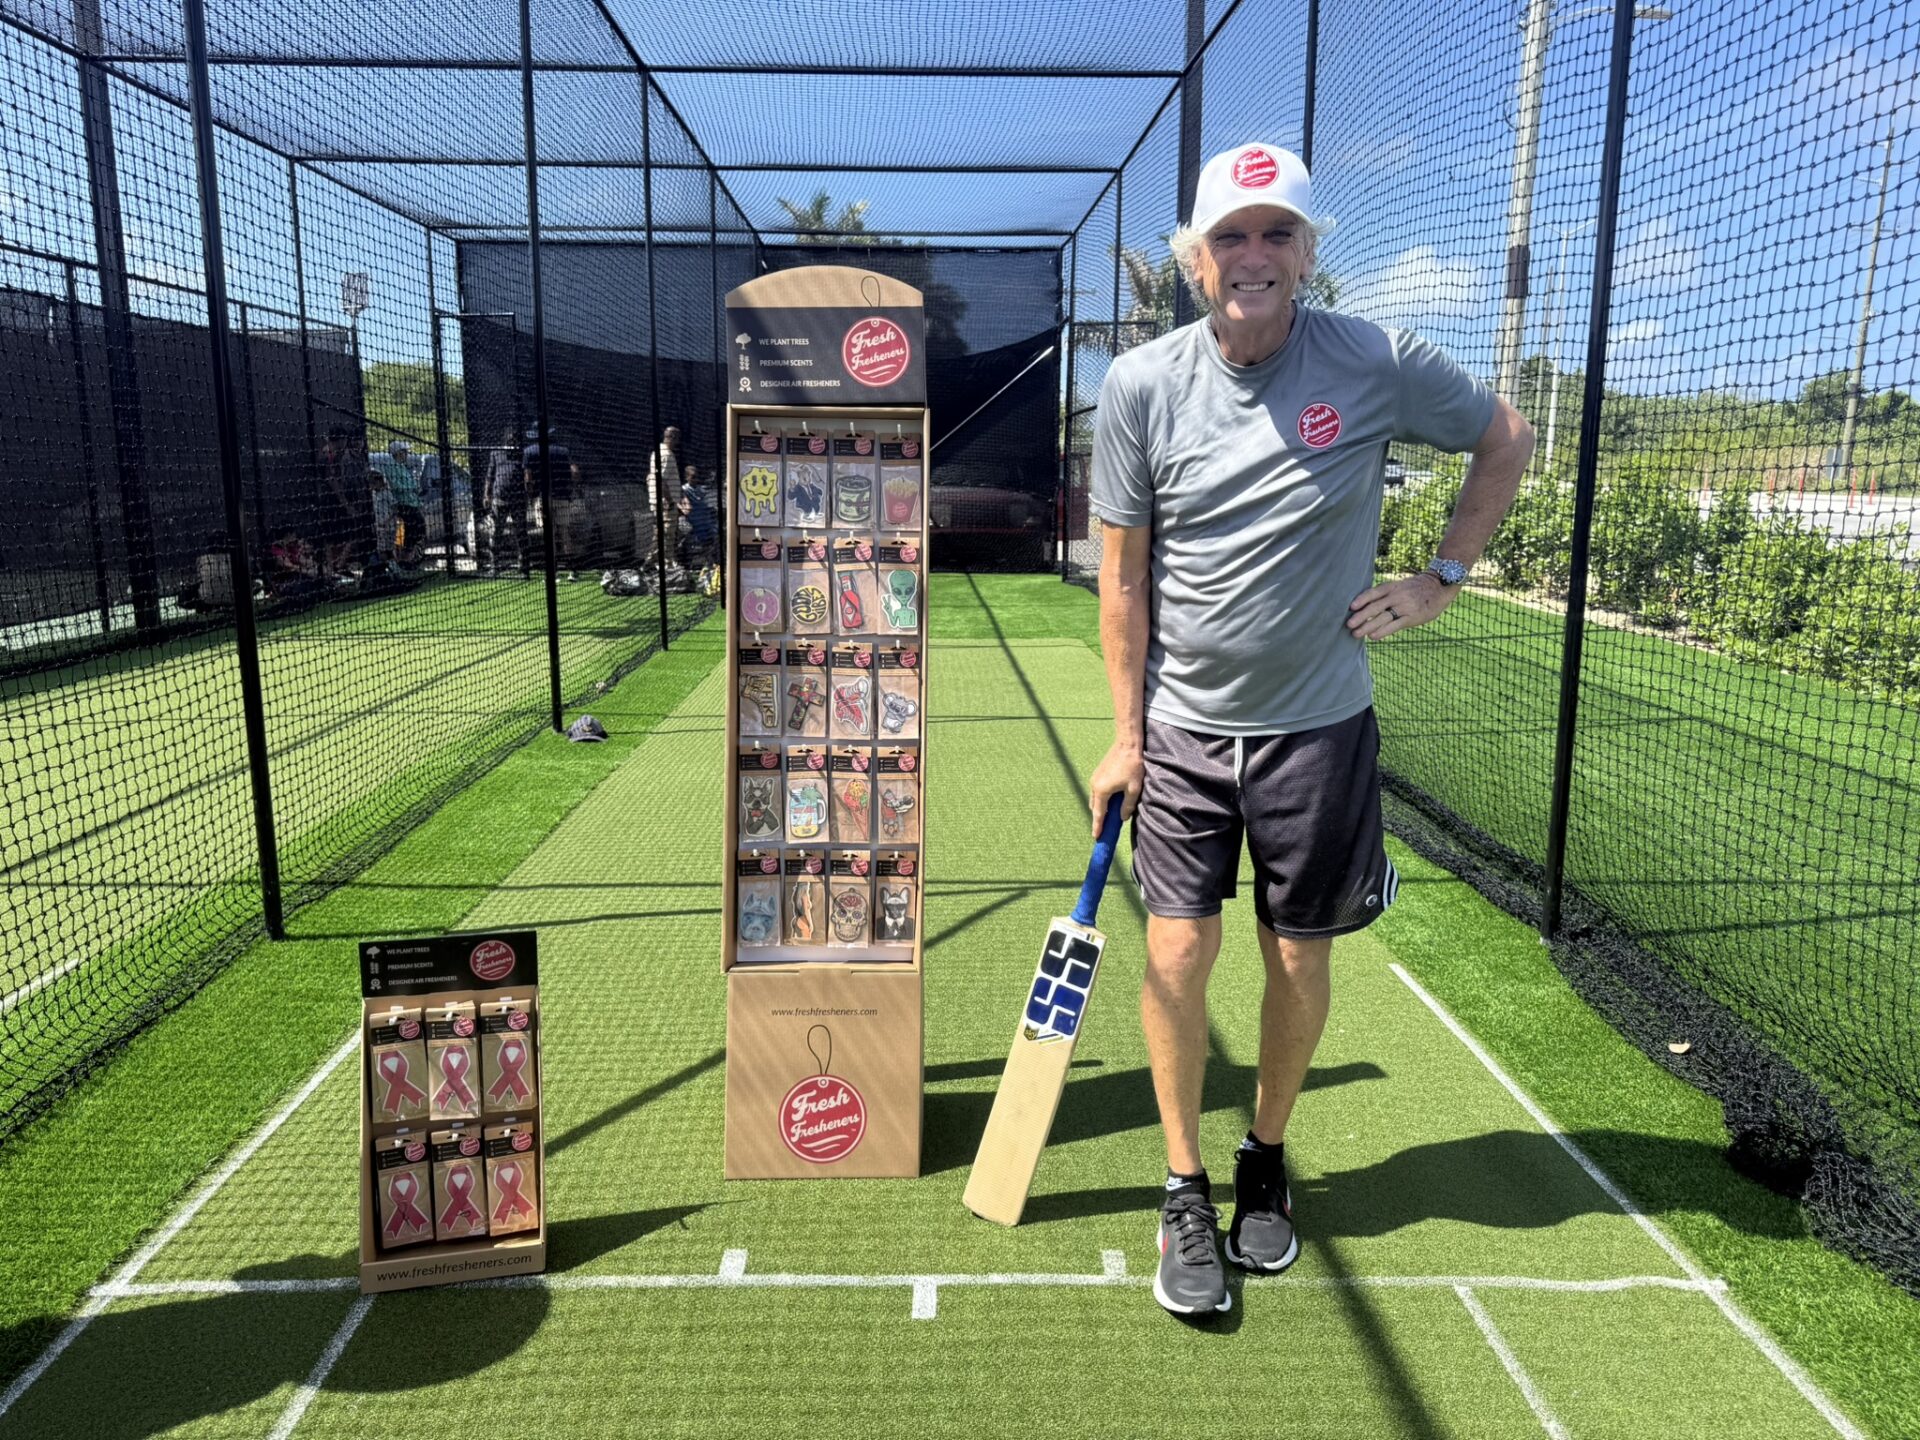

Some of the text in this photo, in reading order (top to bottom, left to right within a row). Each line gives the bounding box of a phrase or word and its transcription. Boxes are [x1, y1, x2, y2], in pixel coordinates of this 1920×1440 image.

[1237, 153, 1270, 171] Fresh
[759, 338, 770, 346] WE
[770, 338, 791, 346] PLANT
[852, 326, 896, 354] Fresh
[790, 359, 813, 367] SCENTS
[851, 347, 905, 371] Fresheners
[760, 380, 790, 388] DESIGNER
[802, 379, 840, 387] FRESHENERS
[1302, 407, 1332, 429] Fresh
[397, 947, 413, 955] PLANT
[476, 945, 507, 962] Fresh
[476, 956, 513, 972] Fresheners
[425, 975, 458, 984] FRESHENERS
[771, 1007, 878, 1017] www.freshfresheners.com
[791, 1087, 851, 1122] Fresh
[790, 1112, 860, 1143] Fresheners
[376, 1253, 532, 1282] www.freshfresheners.com
